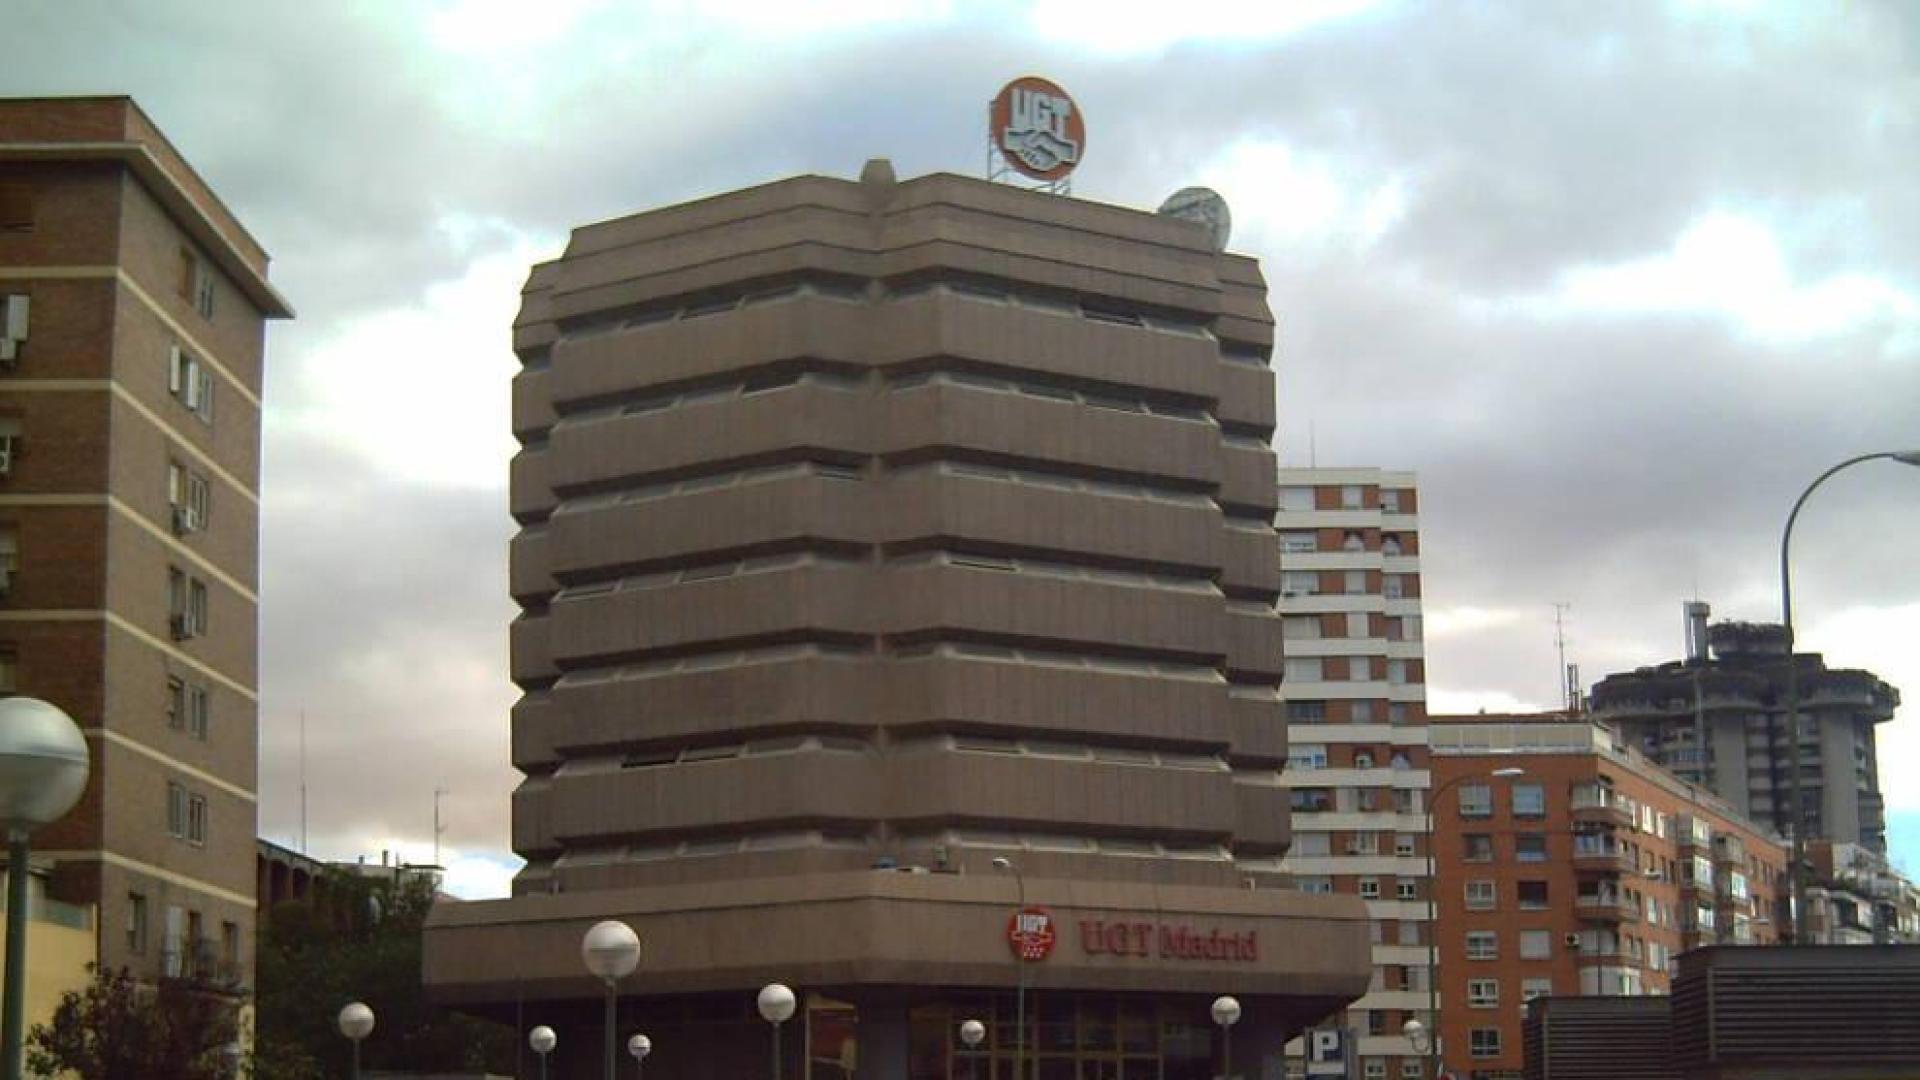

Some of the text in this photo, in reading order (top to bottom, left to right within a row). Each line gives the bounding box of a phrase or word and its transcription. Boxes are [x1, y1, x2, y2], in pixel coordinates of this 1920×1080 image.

[1011, 87, 1072, 138] UGT
[1079, 920, 1258, 962] UGT Madrid
[1314, 1032, 1338, 1061] P
